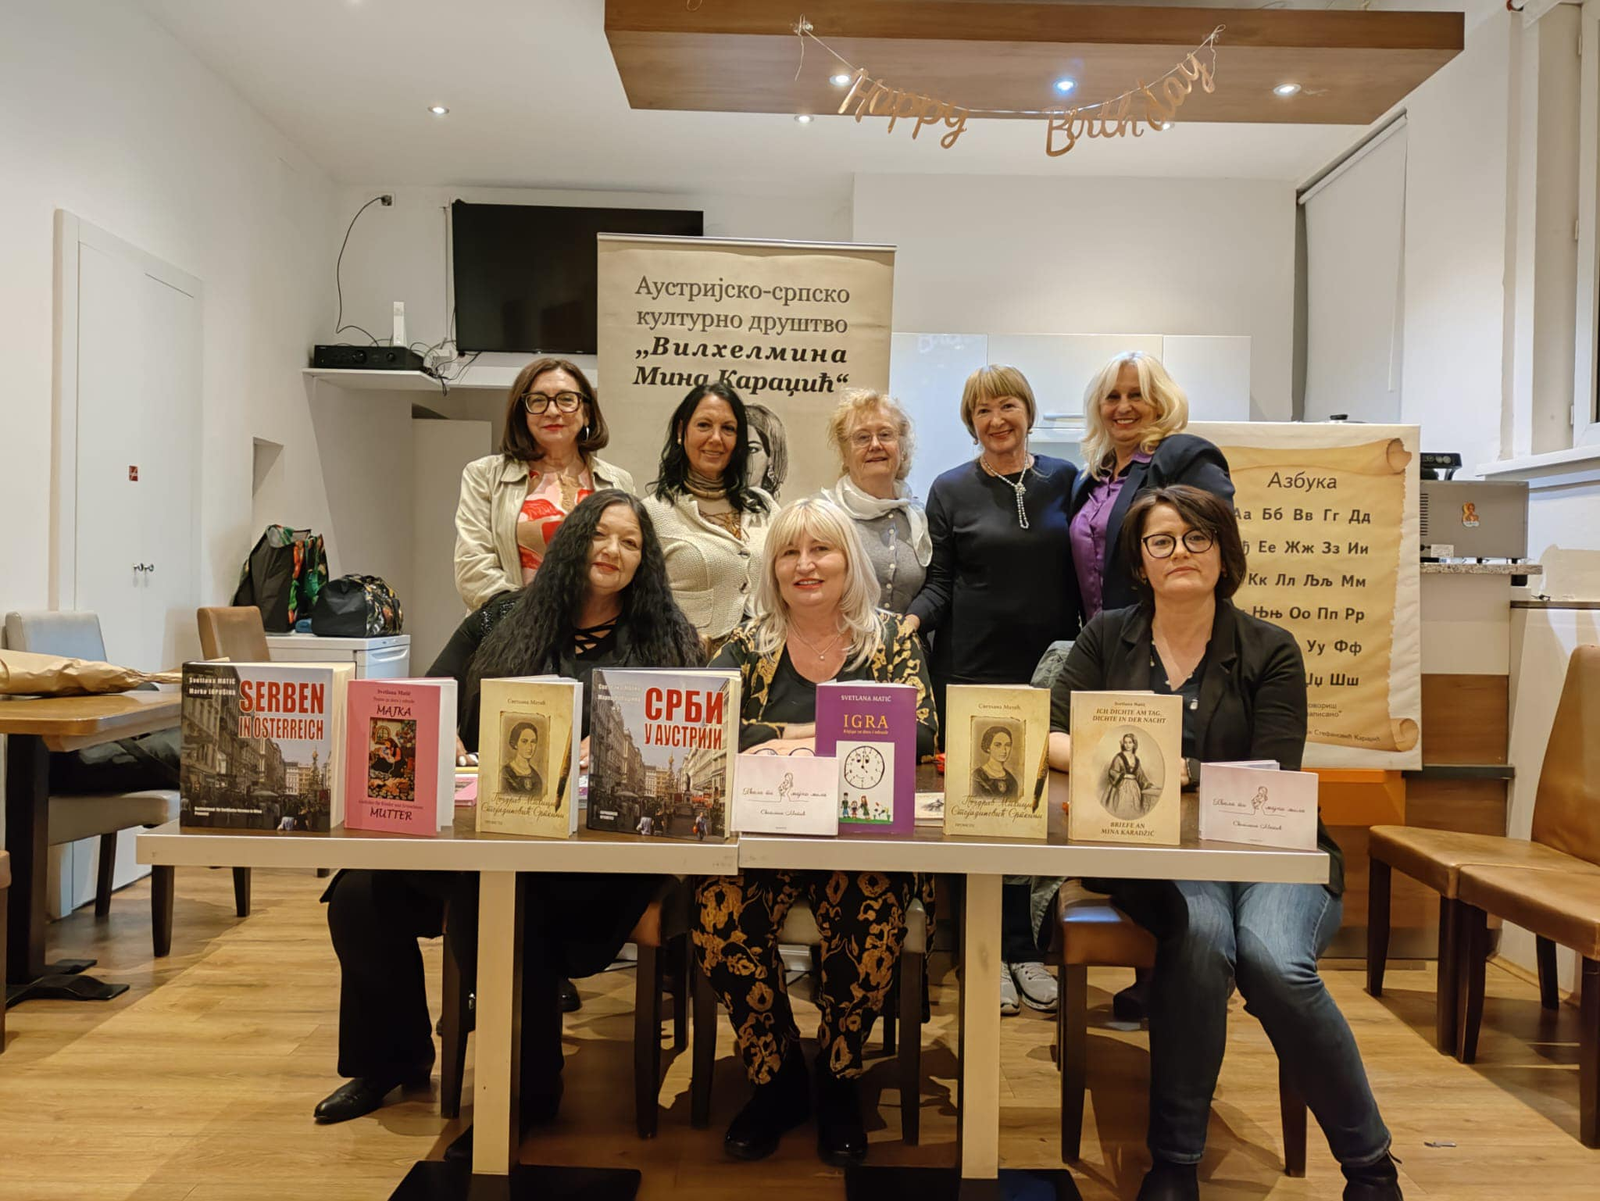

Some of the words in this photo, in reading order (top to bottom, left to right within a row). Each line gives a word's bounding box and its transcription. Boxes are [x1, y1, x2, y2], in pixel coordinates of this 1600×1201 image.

[838, 68, 970, 149] Happy
[634, 275, 850, 306] Аустријско-српско
[636, 310, 743, 332] културно
[748, 314, 848, 335] друштво
[635, 336, 848, 363] „Вилхелмина
[632, 366, 709, 387] Мина
[1267, 470, 1338, 492] Азбука
[1233, 507, 1252, 520] Аа
[1262, 507, 1283, 521] Бб
[1293, 508, 1313, 522] Вв
[1323, 509, 1340, 522] Гг
[1348, 509, 1372, 524] Дд
[1258, 540, 1277, 554] Ее
[1284, 540, 1315, 554] Жж
[1321, 541, 1340, 554] Зз
[1347, 541, 1369, 555] Ии
[1248, 572, 1268, 587] Кк
[1274, 573, 1296, 588] Лл
[1303, 574, 1333, 588] Љљ
[1341, 574, 1367, 588] Мм
[1289, 606, 1311, 620] Оо
[1317, 607, 1338, 620] Пп
[1345, 607, 1365, 623] Рр
[1306, 639, 1326, 655] Уу
[1334, 639, 1362, 656] Фф
[1329, 673, 1359, 686] Шш
[240, 679, 325, 714] SERBEN
[840, 694, 872, 702] SVETLANA
[376, 704, 411, 717] MAJKA
[645, 687, 724, 725] СРБИ
[239, 716, 251, 738] IN
[843, 713, 889, 729] IGRA
[644, 722, 653, 746] У
[654, 724, 722, 750] АУСТРИЈИ
[370, 806, 413, 821] MUTTER
[1110, 821, 1135, 829] BRIEFE
